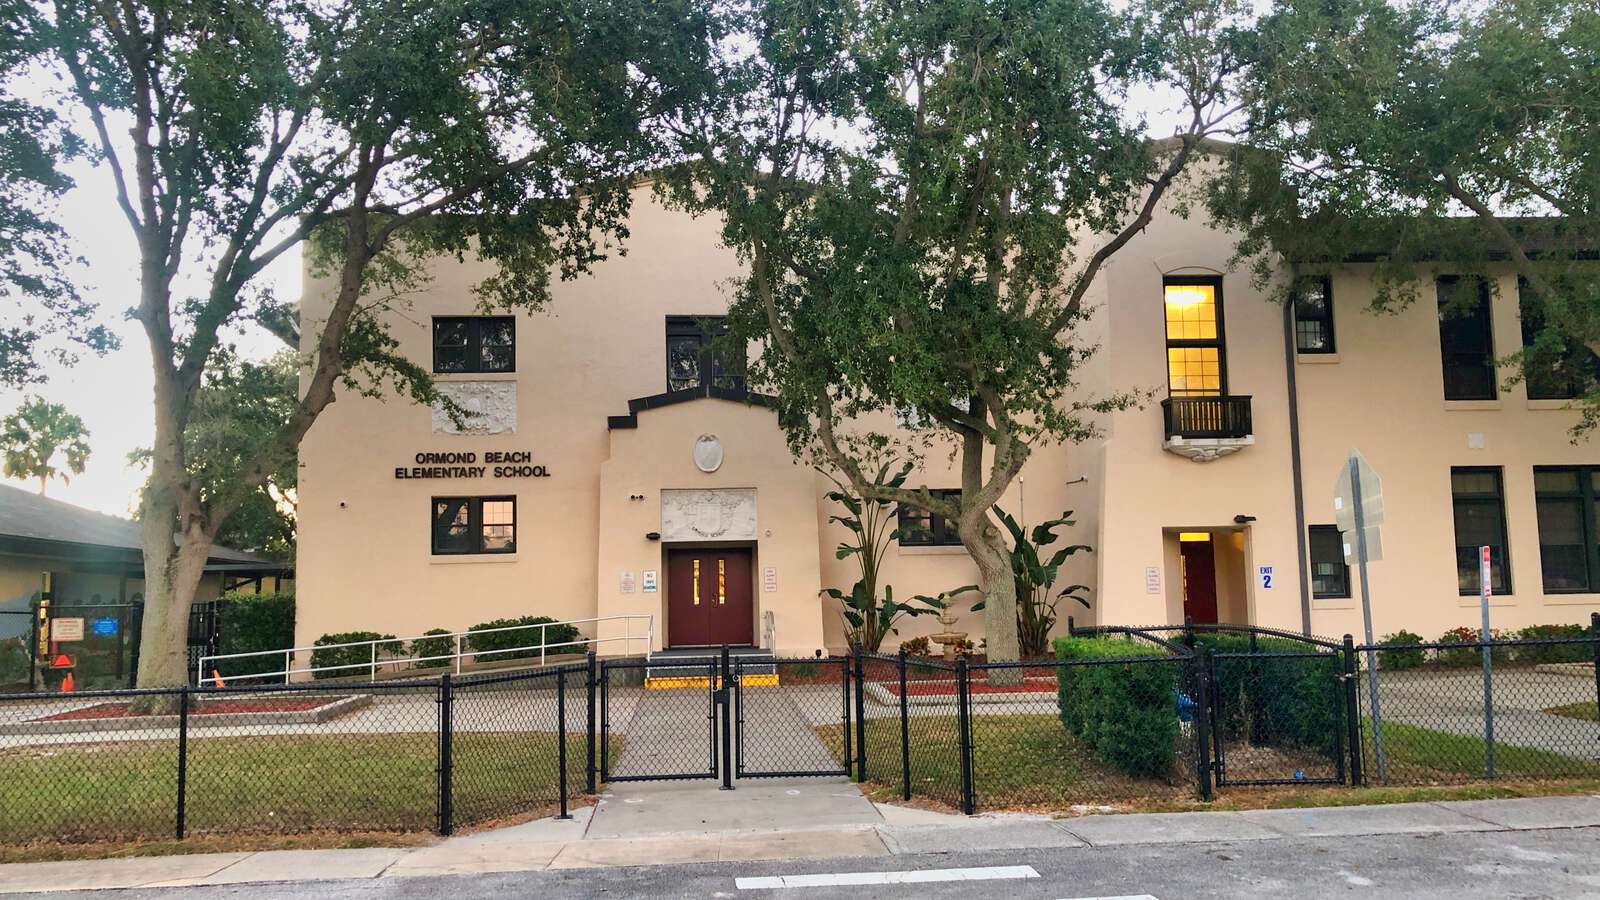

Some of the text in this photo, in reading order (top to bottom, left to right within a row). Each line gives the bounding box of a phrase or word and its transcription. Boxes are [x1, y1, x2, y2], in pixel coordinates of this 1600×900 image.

[415, 452, 531, 464] ORMOND BEACH
[395, 466, 550, 479] ELEMENTARY SCHOOL
[1260, 566, 1273, 574] EXIT
[1263, 575, 1272, 588] 2
